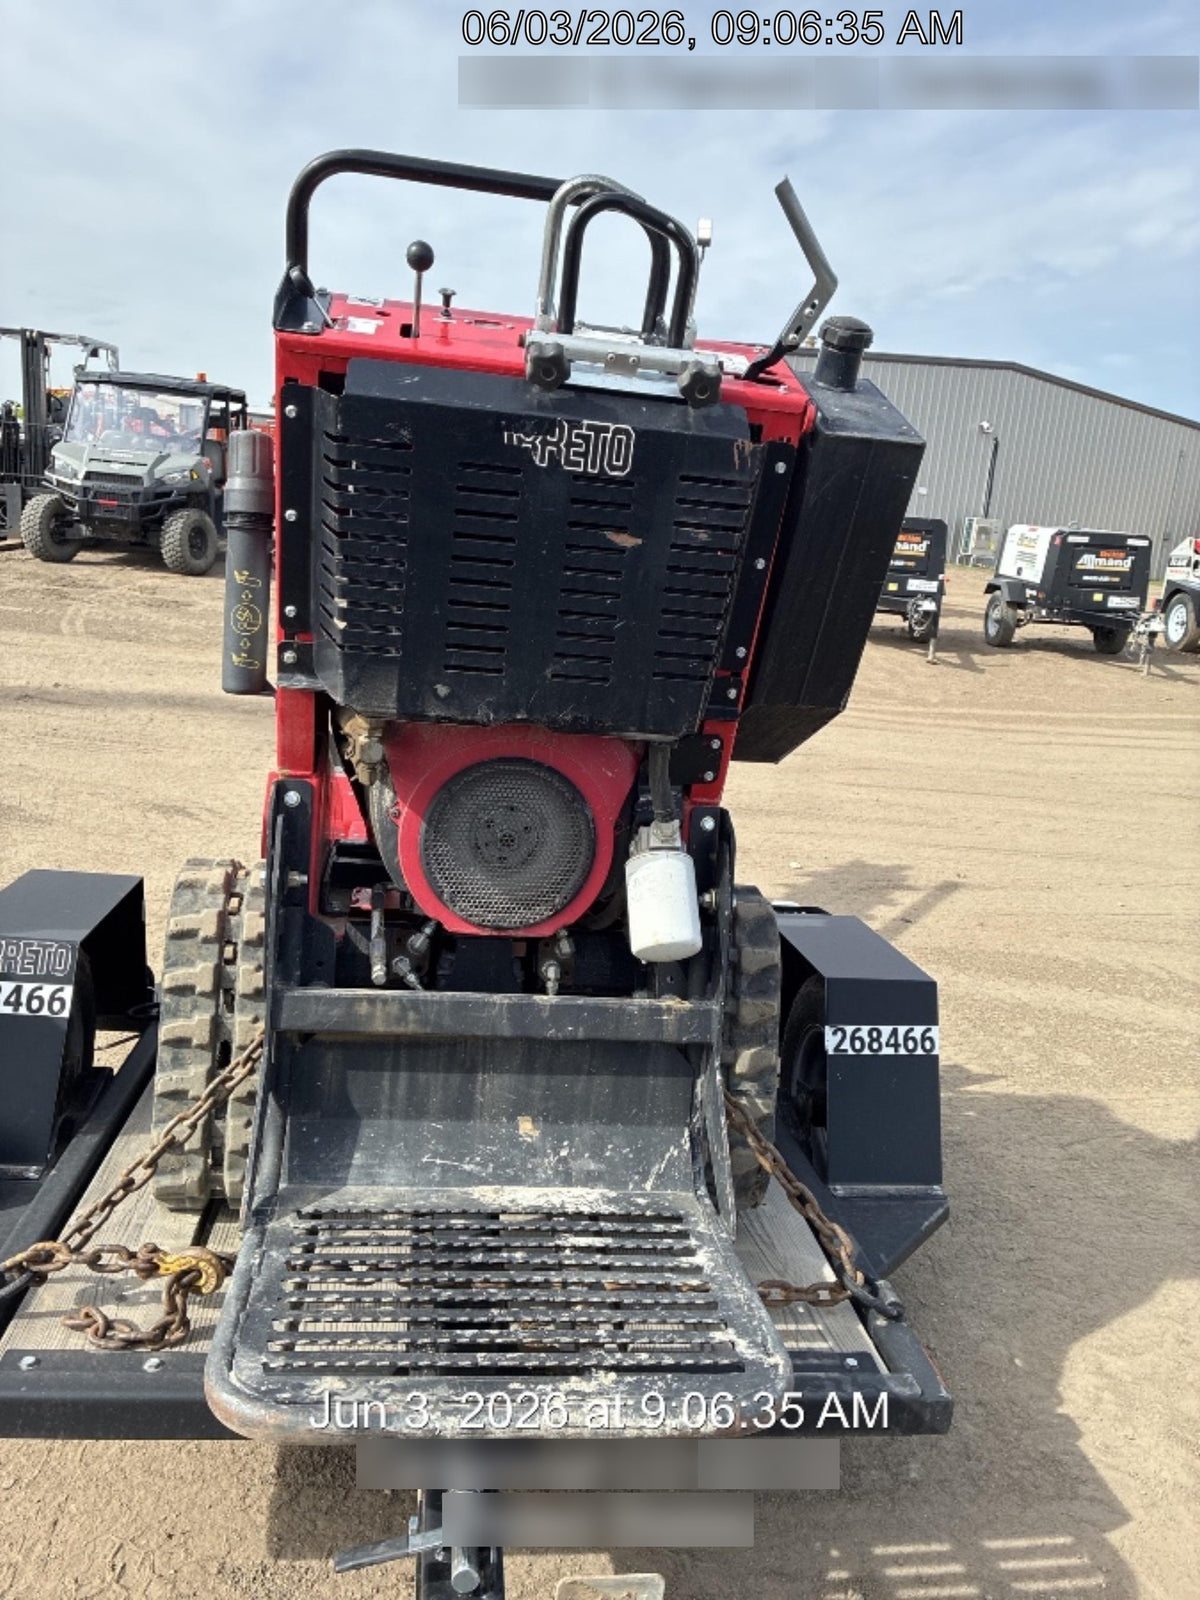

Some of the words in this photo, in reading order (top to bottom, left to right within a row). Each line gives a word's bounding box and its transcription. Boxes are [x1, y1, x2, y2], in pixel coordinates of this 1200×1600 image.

[0, 940, 71, 976] RETO
[0, 984, 66, 1015] 466
[832, 1027, 936, 1053] 268466
